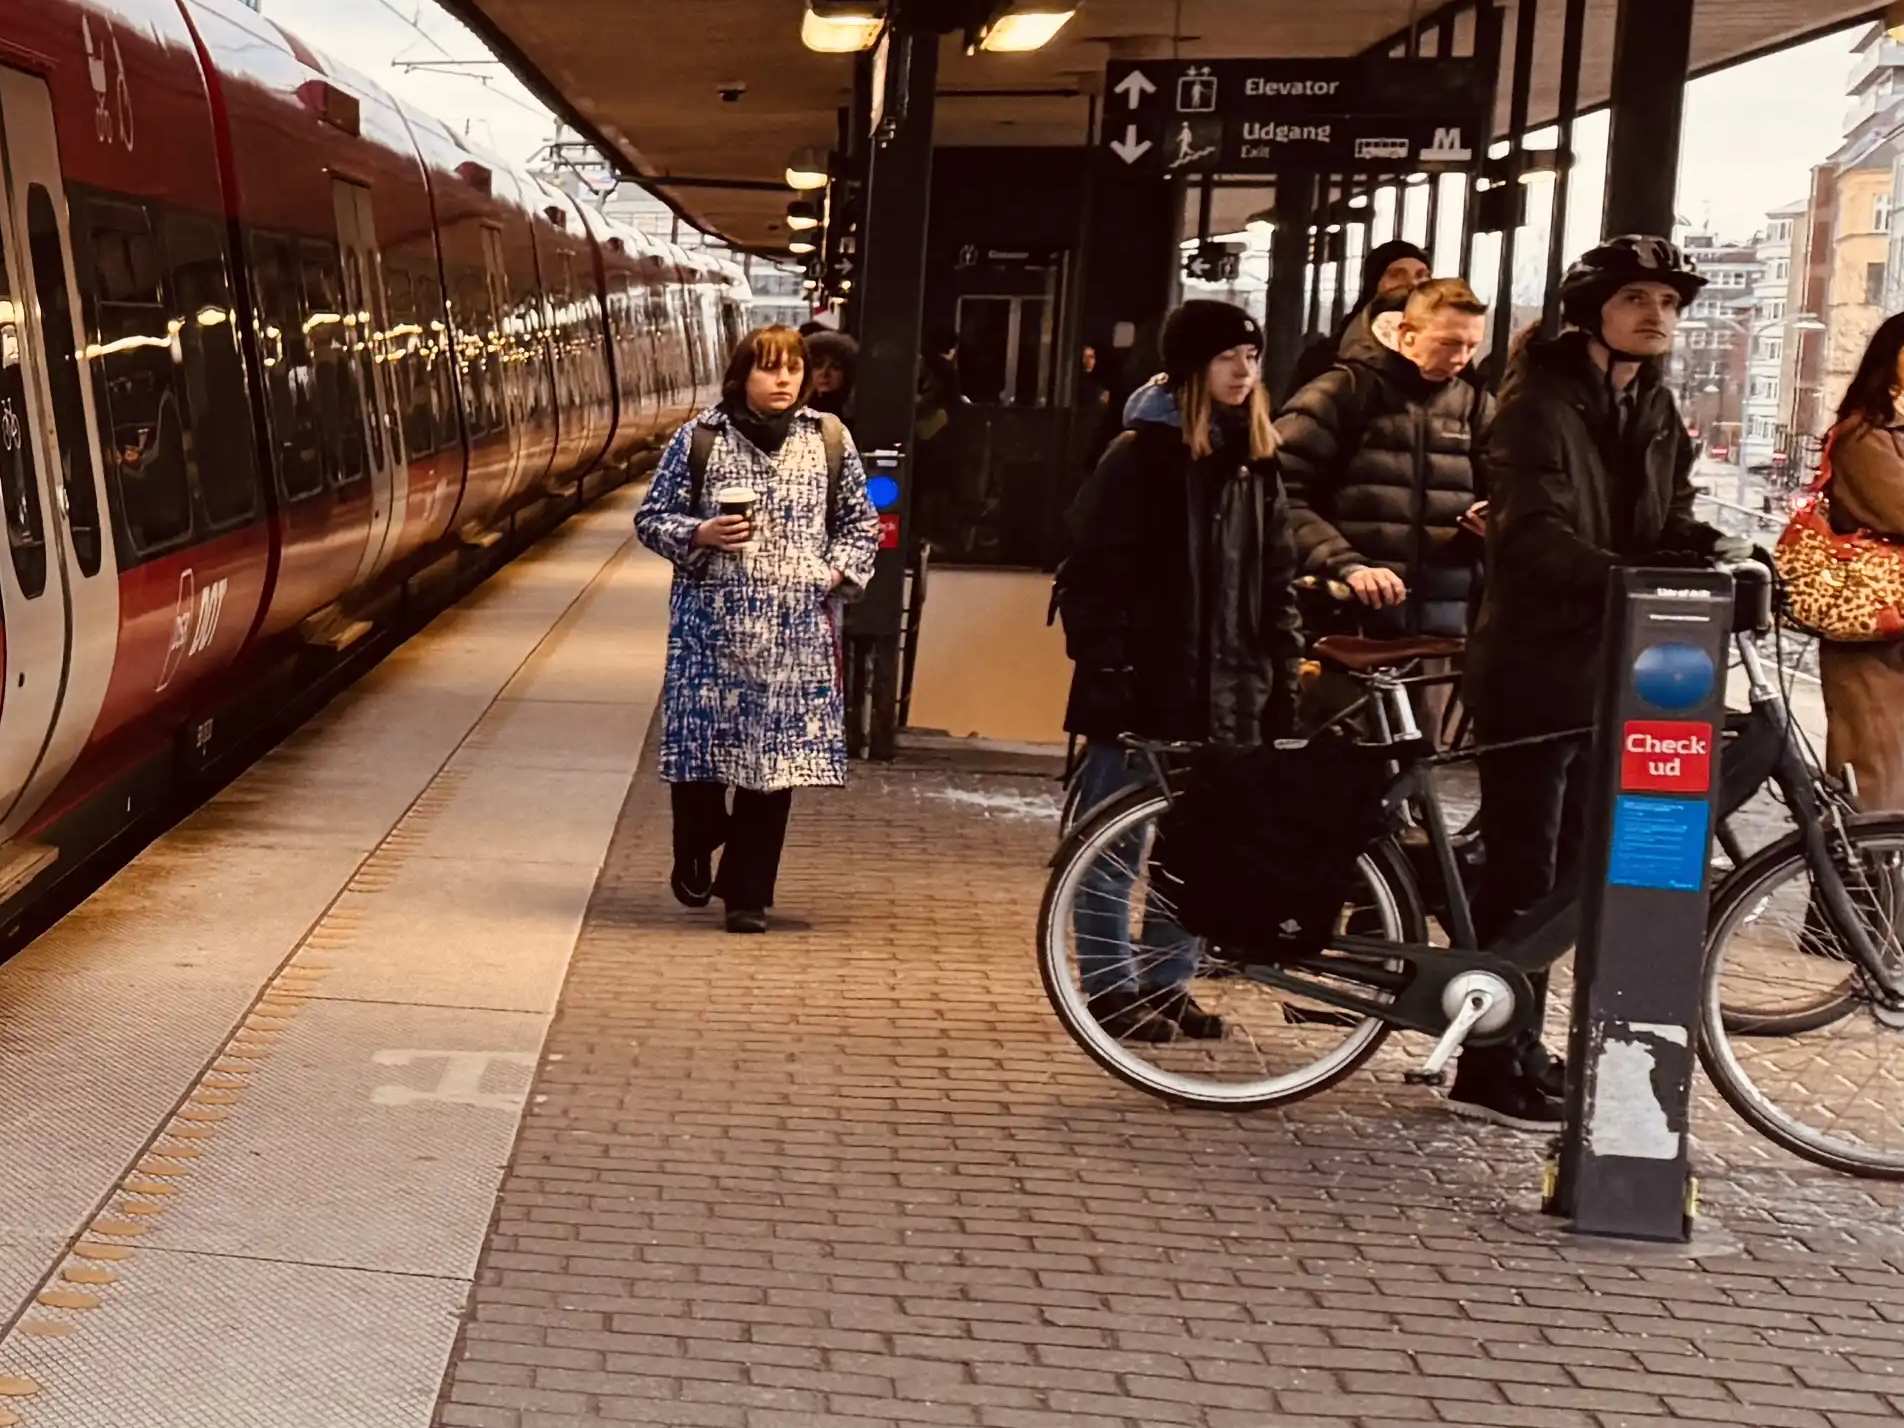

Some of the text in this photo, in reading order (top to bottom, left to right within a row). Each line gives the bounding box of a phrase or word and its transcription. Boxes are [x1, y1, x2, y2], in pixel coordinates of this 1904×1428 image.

[1244, 77, 1340, 97] Elevator
[1242, 121, 1332, 143] Udgang
[1241, 145, 1271, 160] Exit
[1626, 733, 1707, 756] Check
[1648, 758, 1681, 777] ud
